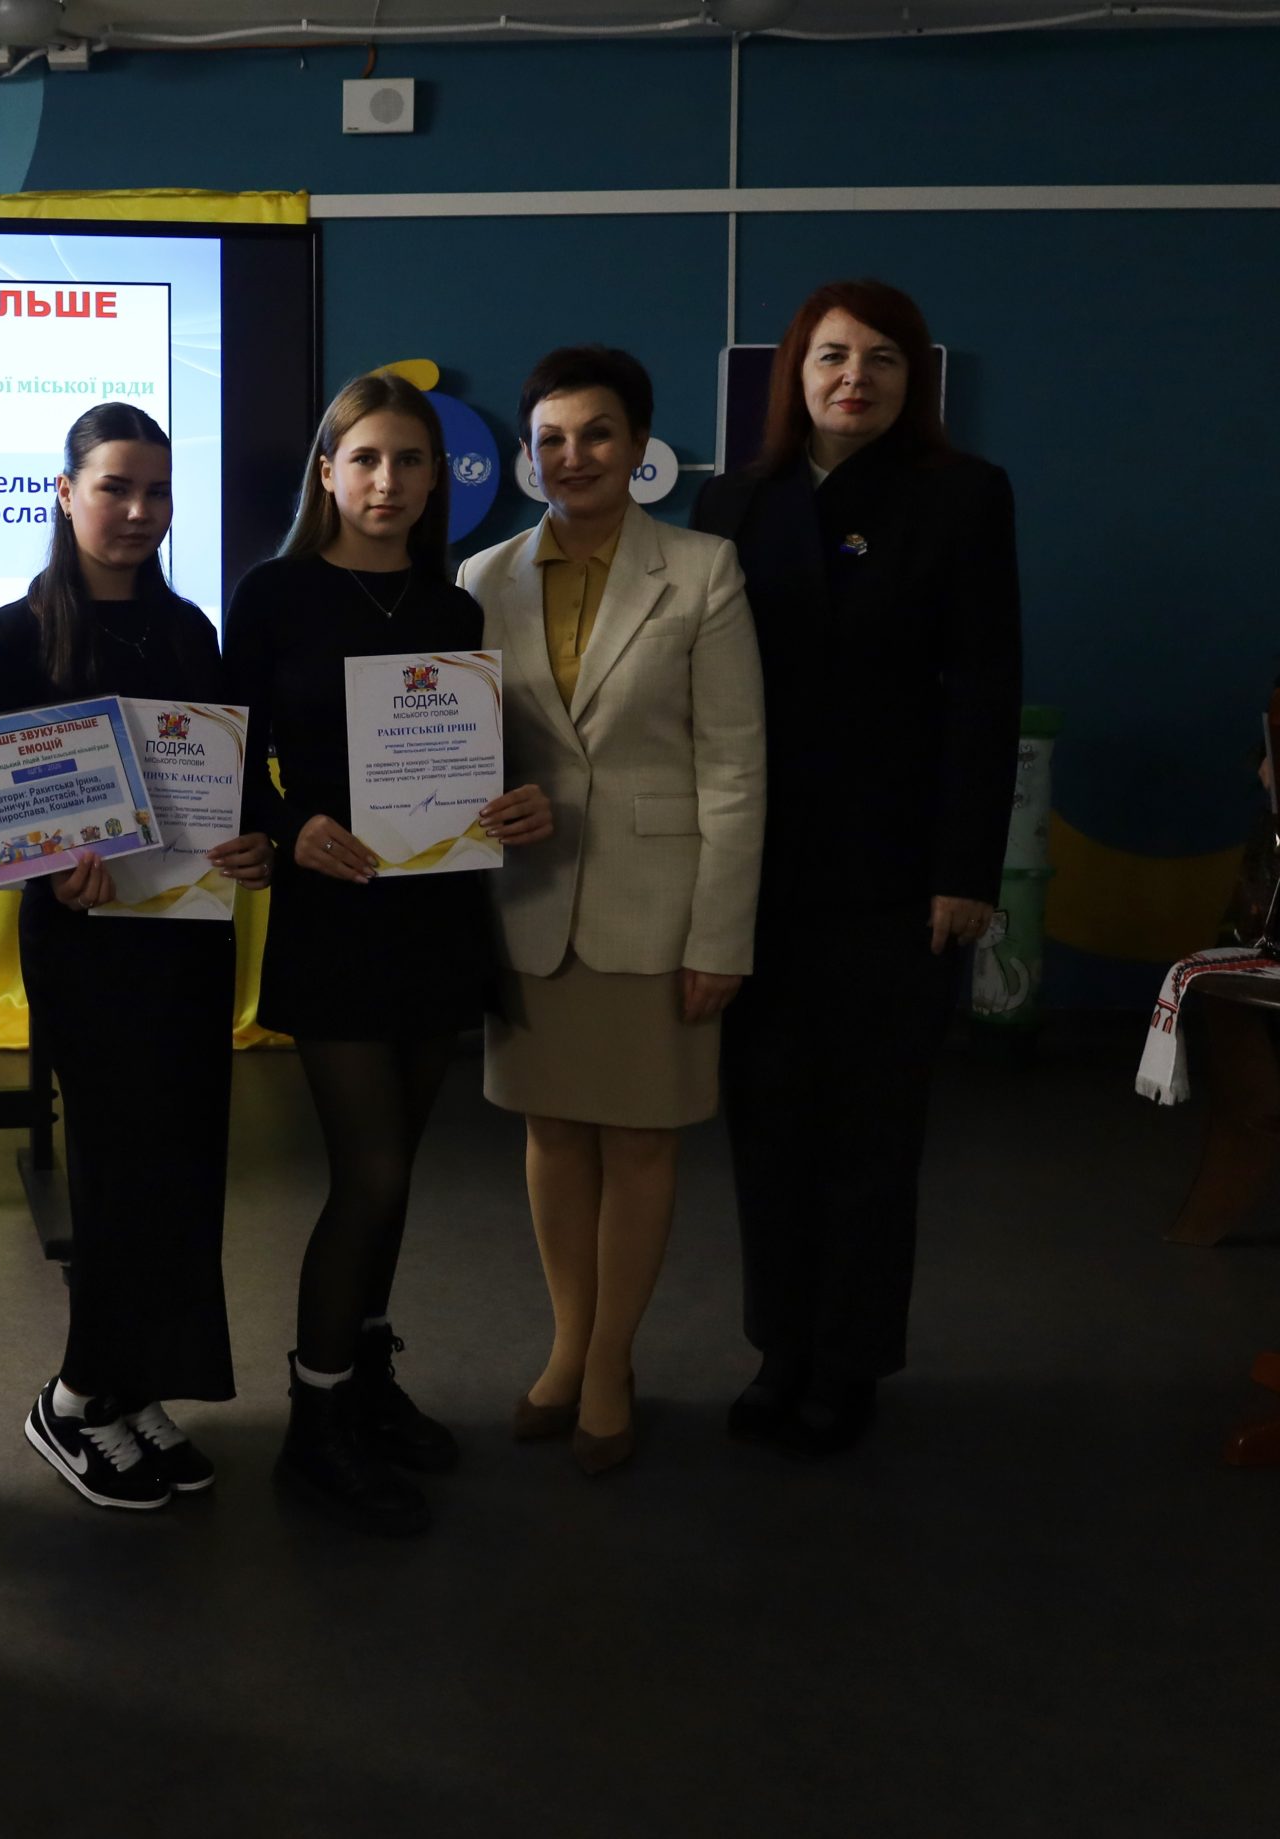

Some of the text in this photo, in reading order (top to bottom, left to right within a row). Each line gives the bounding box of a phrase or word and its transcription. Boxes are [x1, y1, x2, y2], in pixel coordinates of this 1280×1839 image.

[17, 377, 97, 395] міської
[101, 382, 155, 398] ради
[393, 692, 457, 710] ПОДЯКА
[393, 711, 428, 719] МІСЬКОГО
[18, 717, 98, 742] ЗВУКУ-БІЛЬШЕ
[377, 722, 476, 736] РАКИТСЬКІЙ ІРИНІ
[17, 737, 63, 756] ЕМОЦІЙ
[145, 740, 205, 758] ПОДЯКА
[178, 758, 204, 766] ГОЛОВИ
[181, 772, 232, 784] АНАСТАСІЇ
[28, 779, 74, 797] Ракитська
